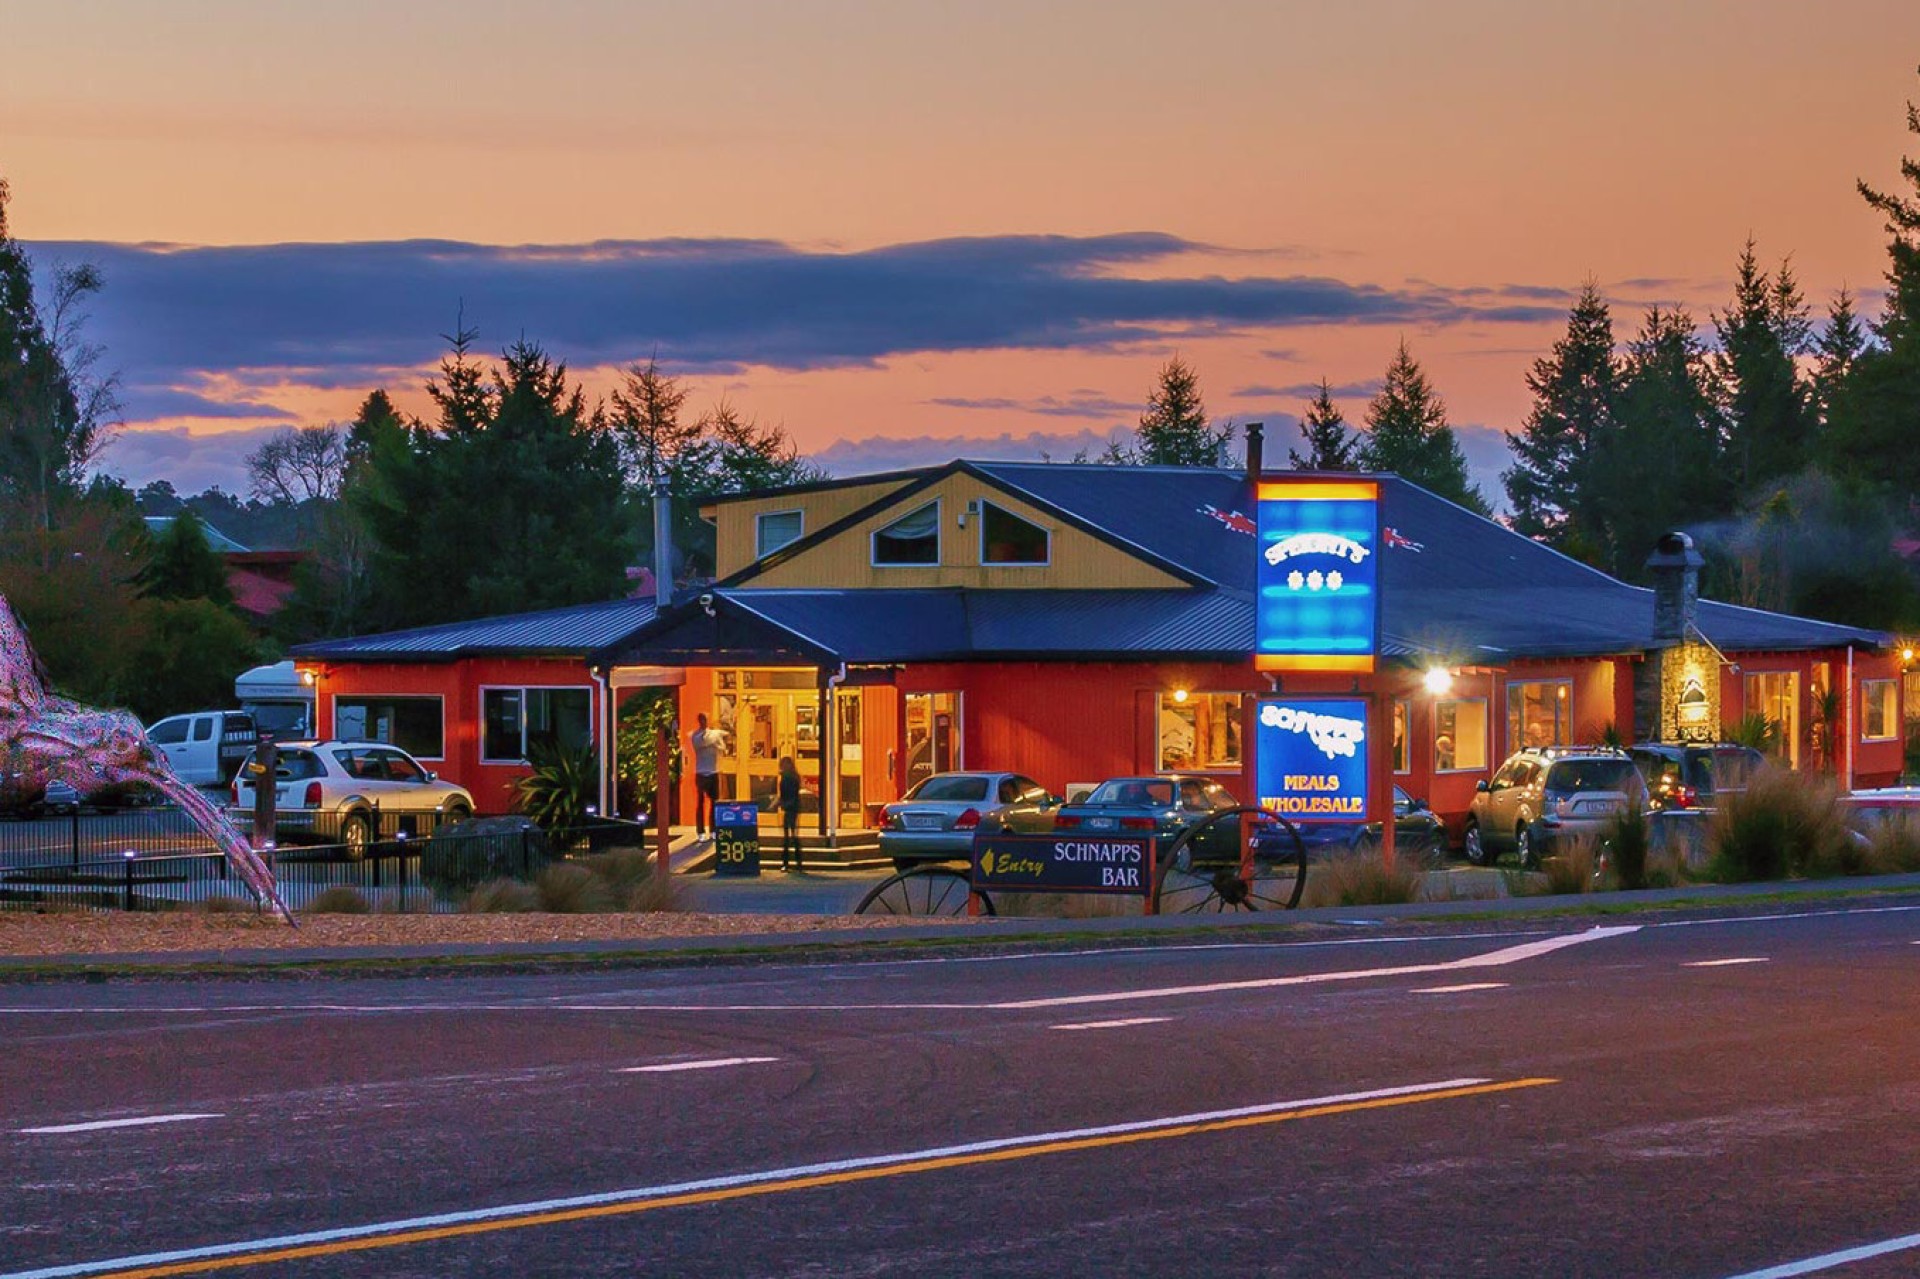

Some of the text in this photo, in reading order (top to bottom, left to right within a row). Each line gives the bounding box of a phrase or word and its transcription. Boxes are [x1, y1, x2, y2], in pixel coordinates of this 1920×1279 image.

[1284, 774, 1340, 791] MEALS
[1261, 797, 1363, 813] WHOLESALE
[1054, 842, 1142, 863] SCHNAPPS
[996, 852, 1045, 877] Entry
[1102, 868, 1139, 887] BAR
